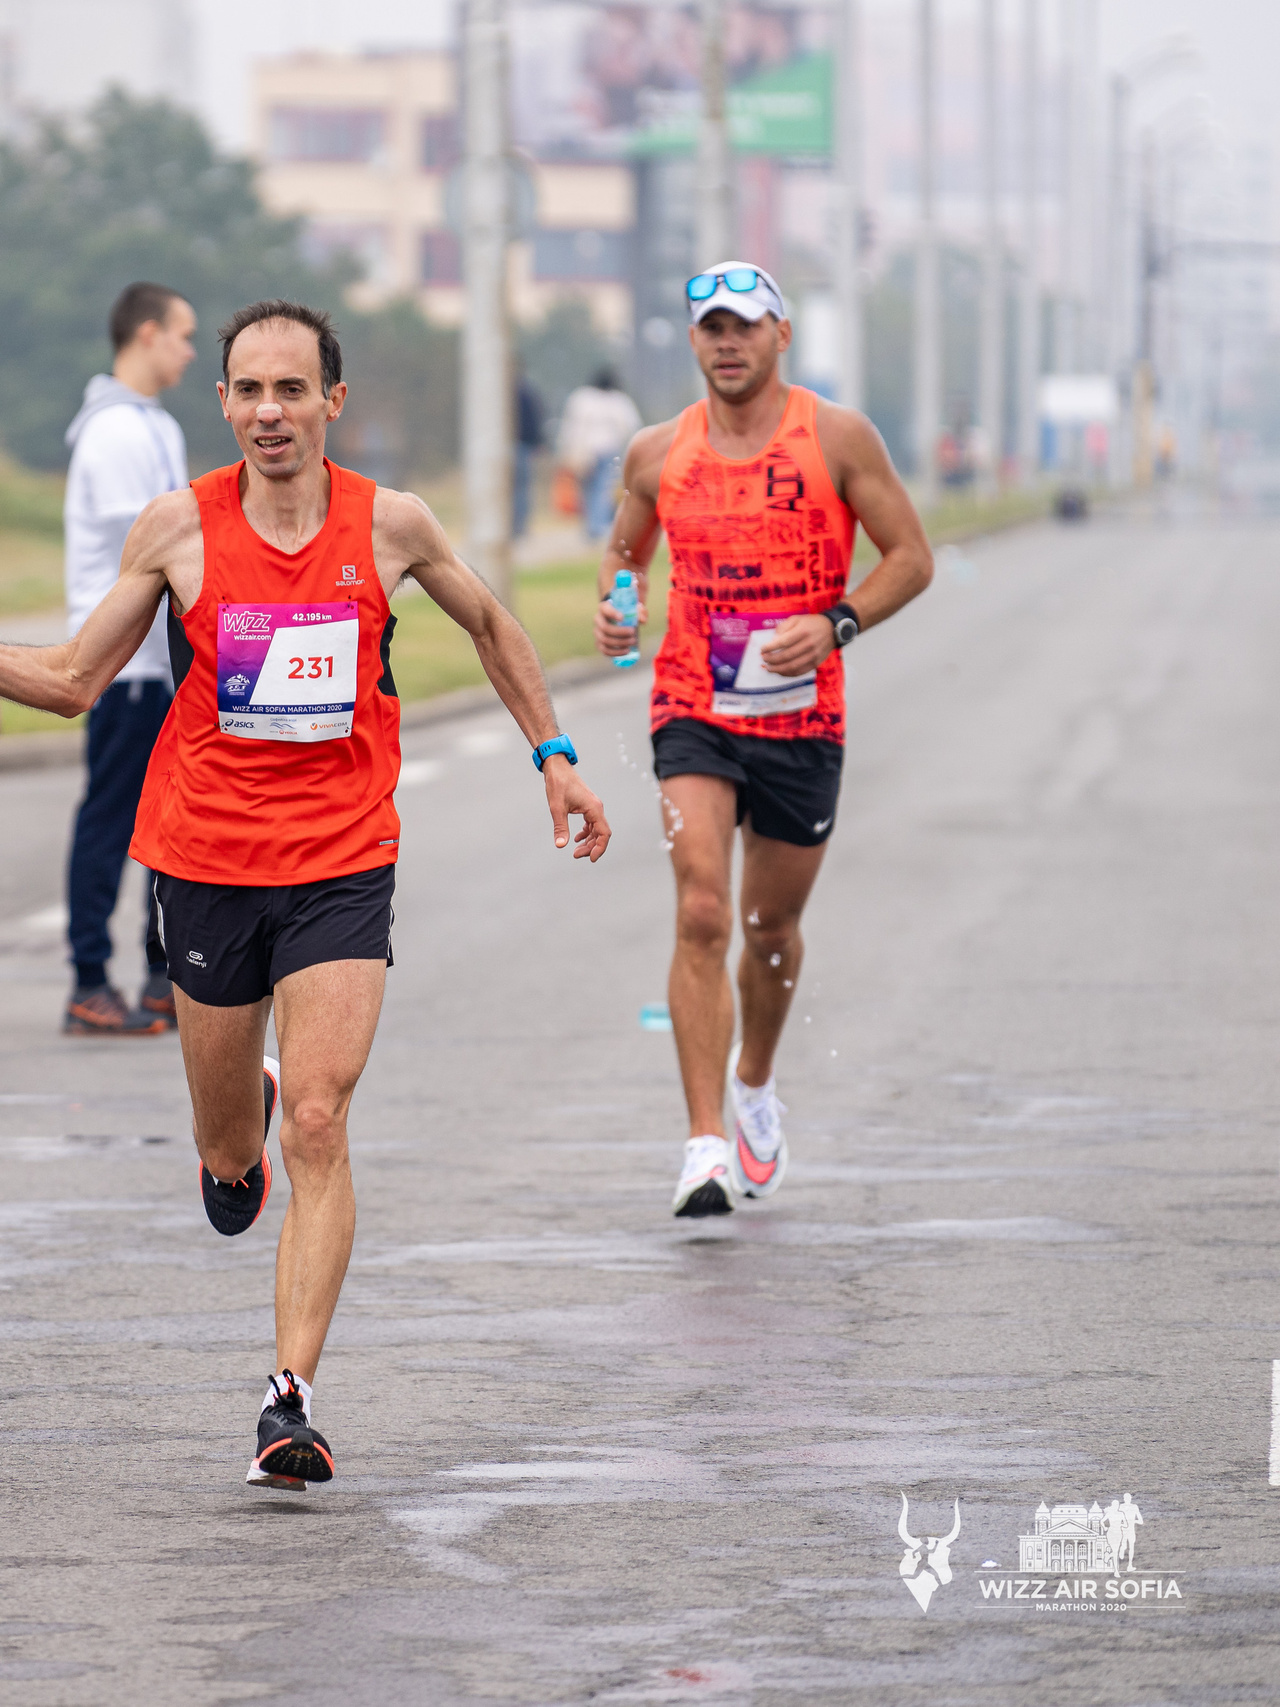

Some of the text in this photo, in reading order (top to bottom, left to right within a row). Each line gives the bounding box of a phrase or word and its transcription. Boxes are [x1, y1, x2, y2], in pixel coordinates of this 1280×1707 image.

[292, 613, 321, 621] 42.195
[288, 656, 334, 679] 231
[287, 705, 326, 713] MARATHON
[327, 704, 342, 712] 2020
